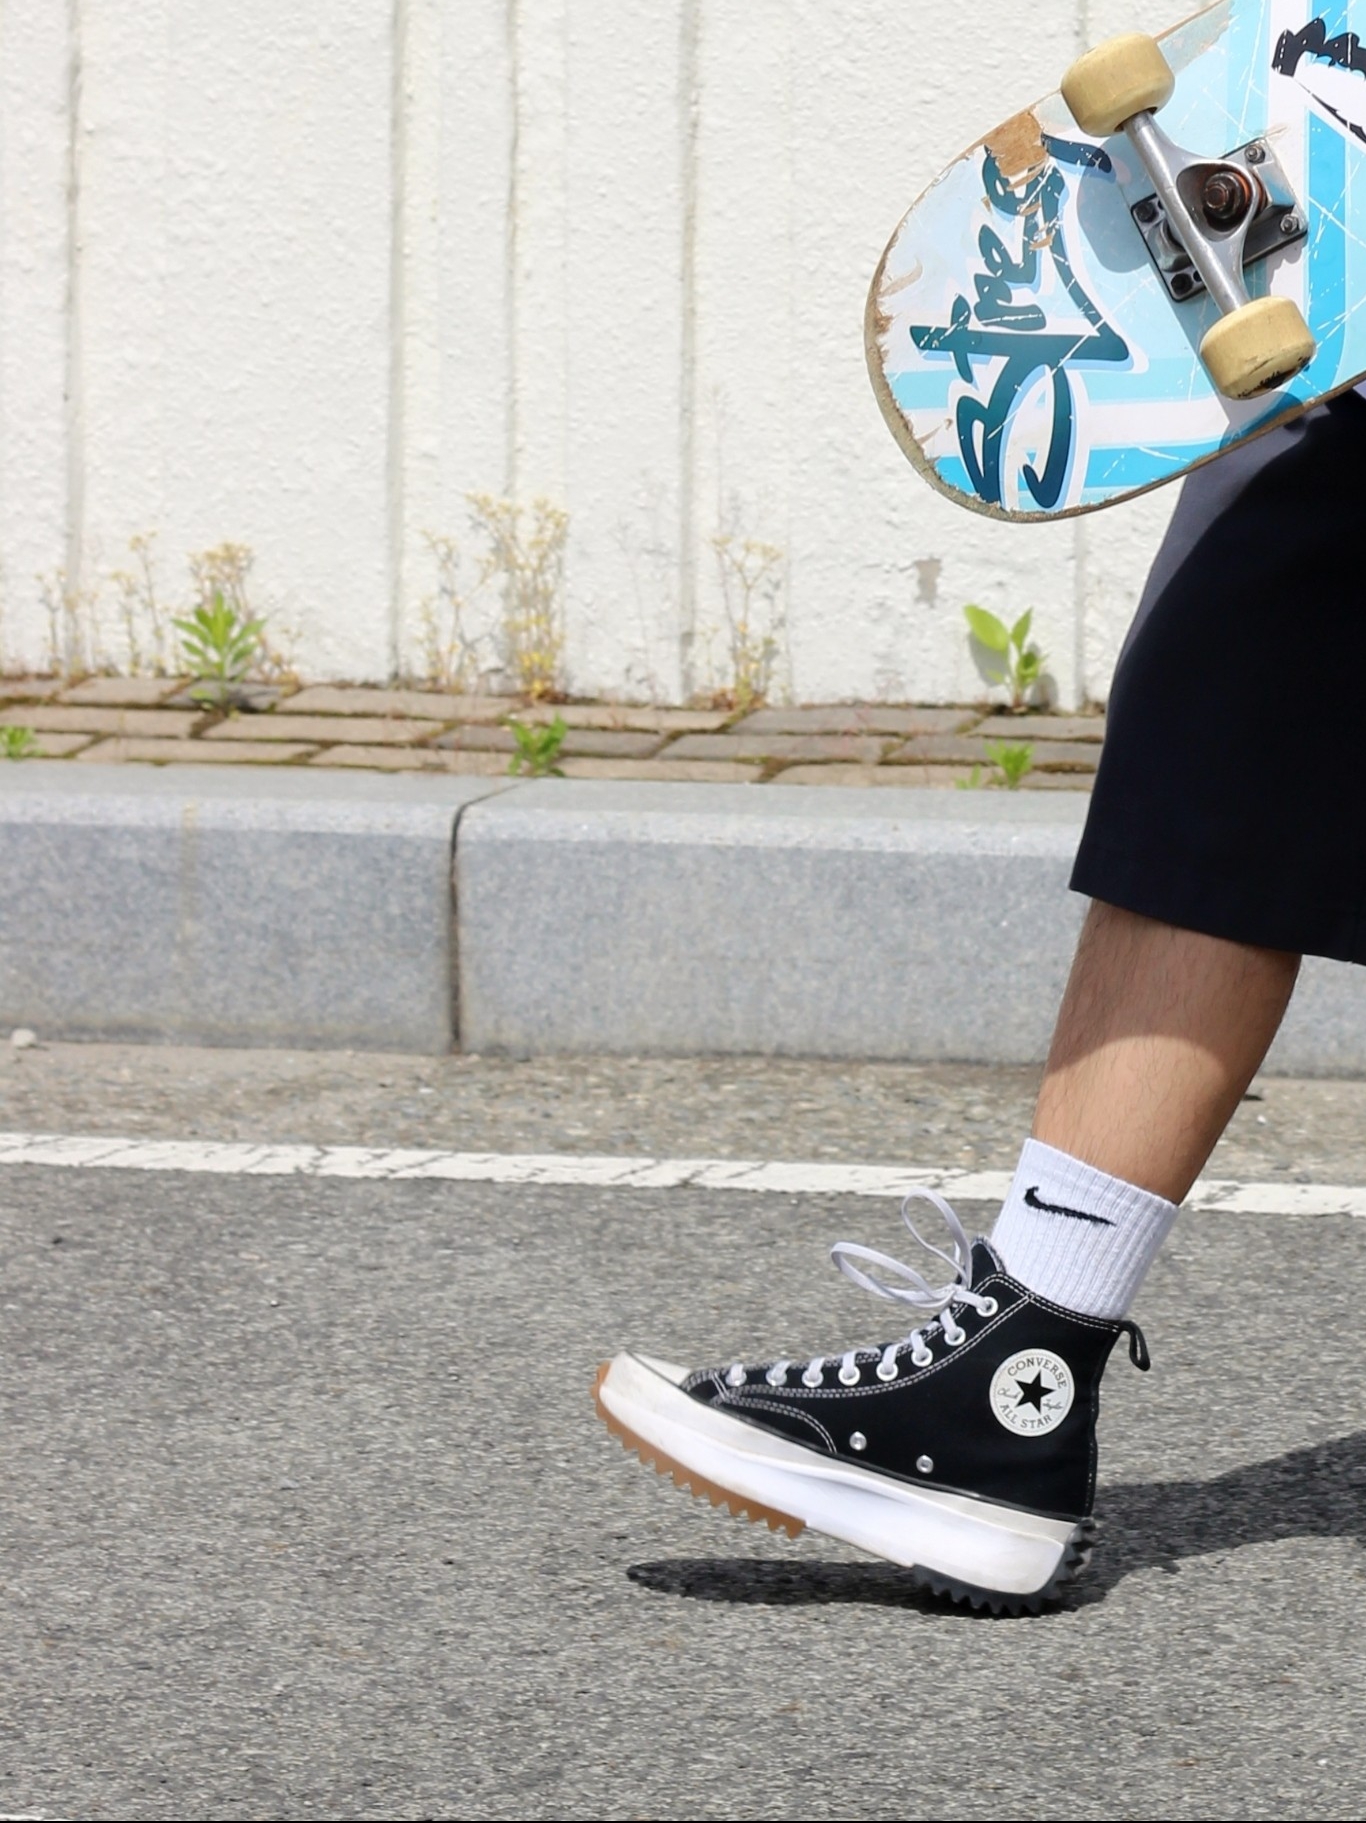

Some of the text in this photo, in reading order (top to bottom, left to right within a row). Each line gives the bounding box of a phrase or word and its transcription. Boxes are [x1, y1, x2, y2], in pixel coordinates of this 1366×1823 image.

[1007, 1357, 1067, 1388] CONVERSE
[1000, 1403, 1053, 1429] ALL STAR
